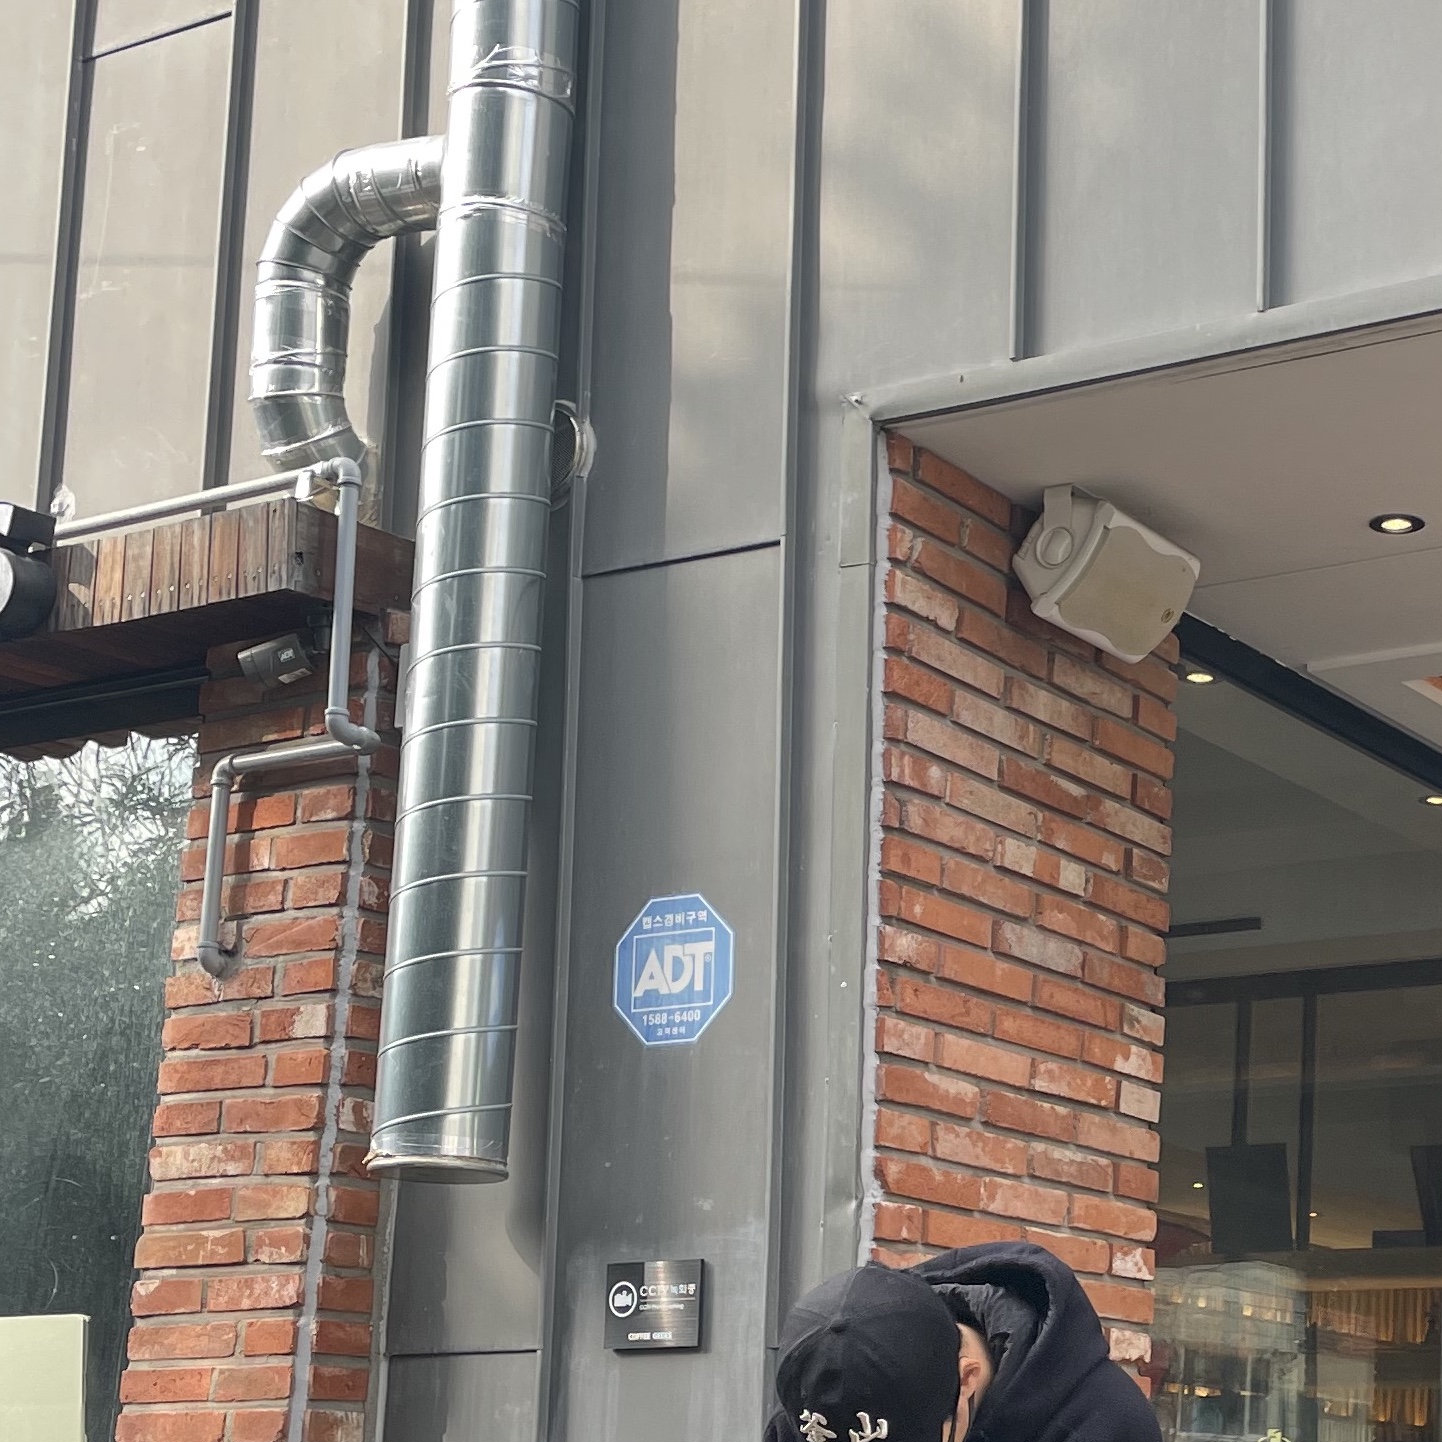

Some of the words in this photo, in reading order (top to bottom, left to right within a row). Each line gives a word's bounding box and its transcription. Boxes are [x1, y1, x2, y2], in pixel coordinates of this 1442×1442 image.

[642, 910, 708, 930] 캡스경비구역
[633, 941, 714, 998] ADT
[642, 1010, 701, 1027] 1588-6400
[639, 1285, 670, 1297] CCTV
